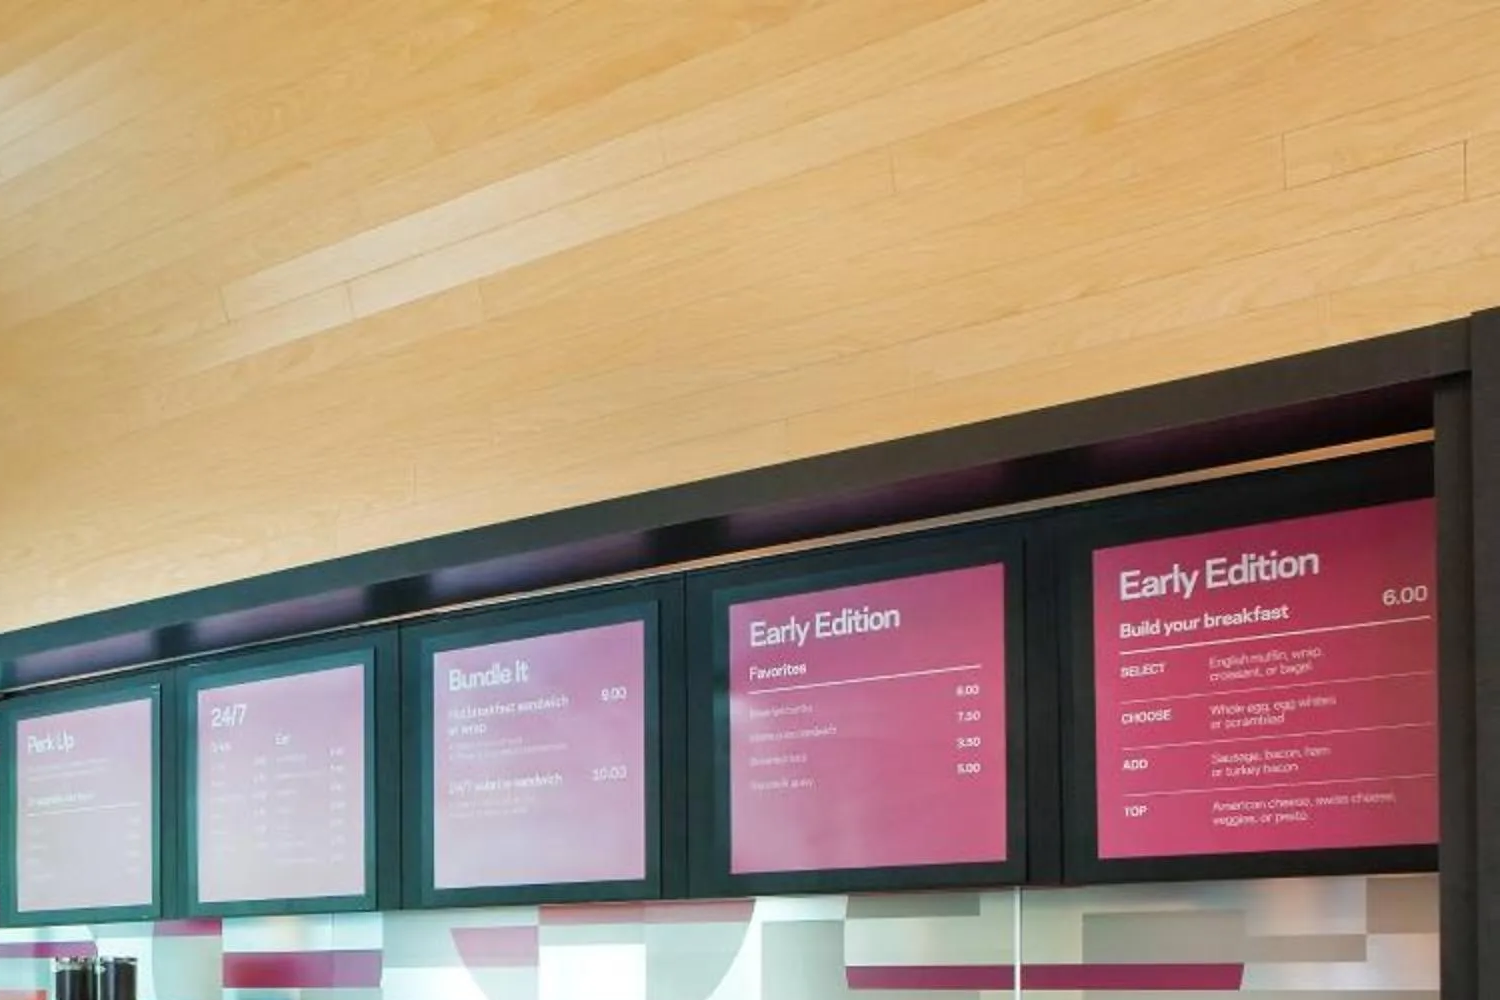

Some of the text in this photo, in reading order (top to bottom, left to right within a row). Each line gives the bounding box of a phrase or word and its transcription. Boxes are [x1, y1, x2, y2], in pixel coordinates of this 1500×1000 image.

[1119, 550, 1319, 600] Early Edition
[1382, 585, 1428, 607] 6.00
[748, 605, 901, 648] Early Edition
[1119, 603, 1290, 639] Build your breakfast
[448, 659, 530, 692] Bundle It
[748, 661, 808, 682] Favorites
[1120, 662, 1167, 679] SELECT
[209, 702, 249, 728] 24/7
[1121, 709, 1172, 725] CHOOSE
[1122, 758, 1149, 771] ADD
[1124, 805, 1149, 818] TOP
